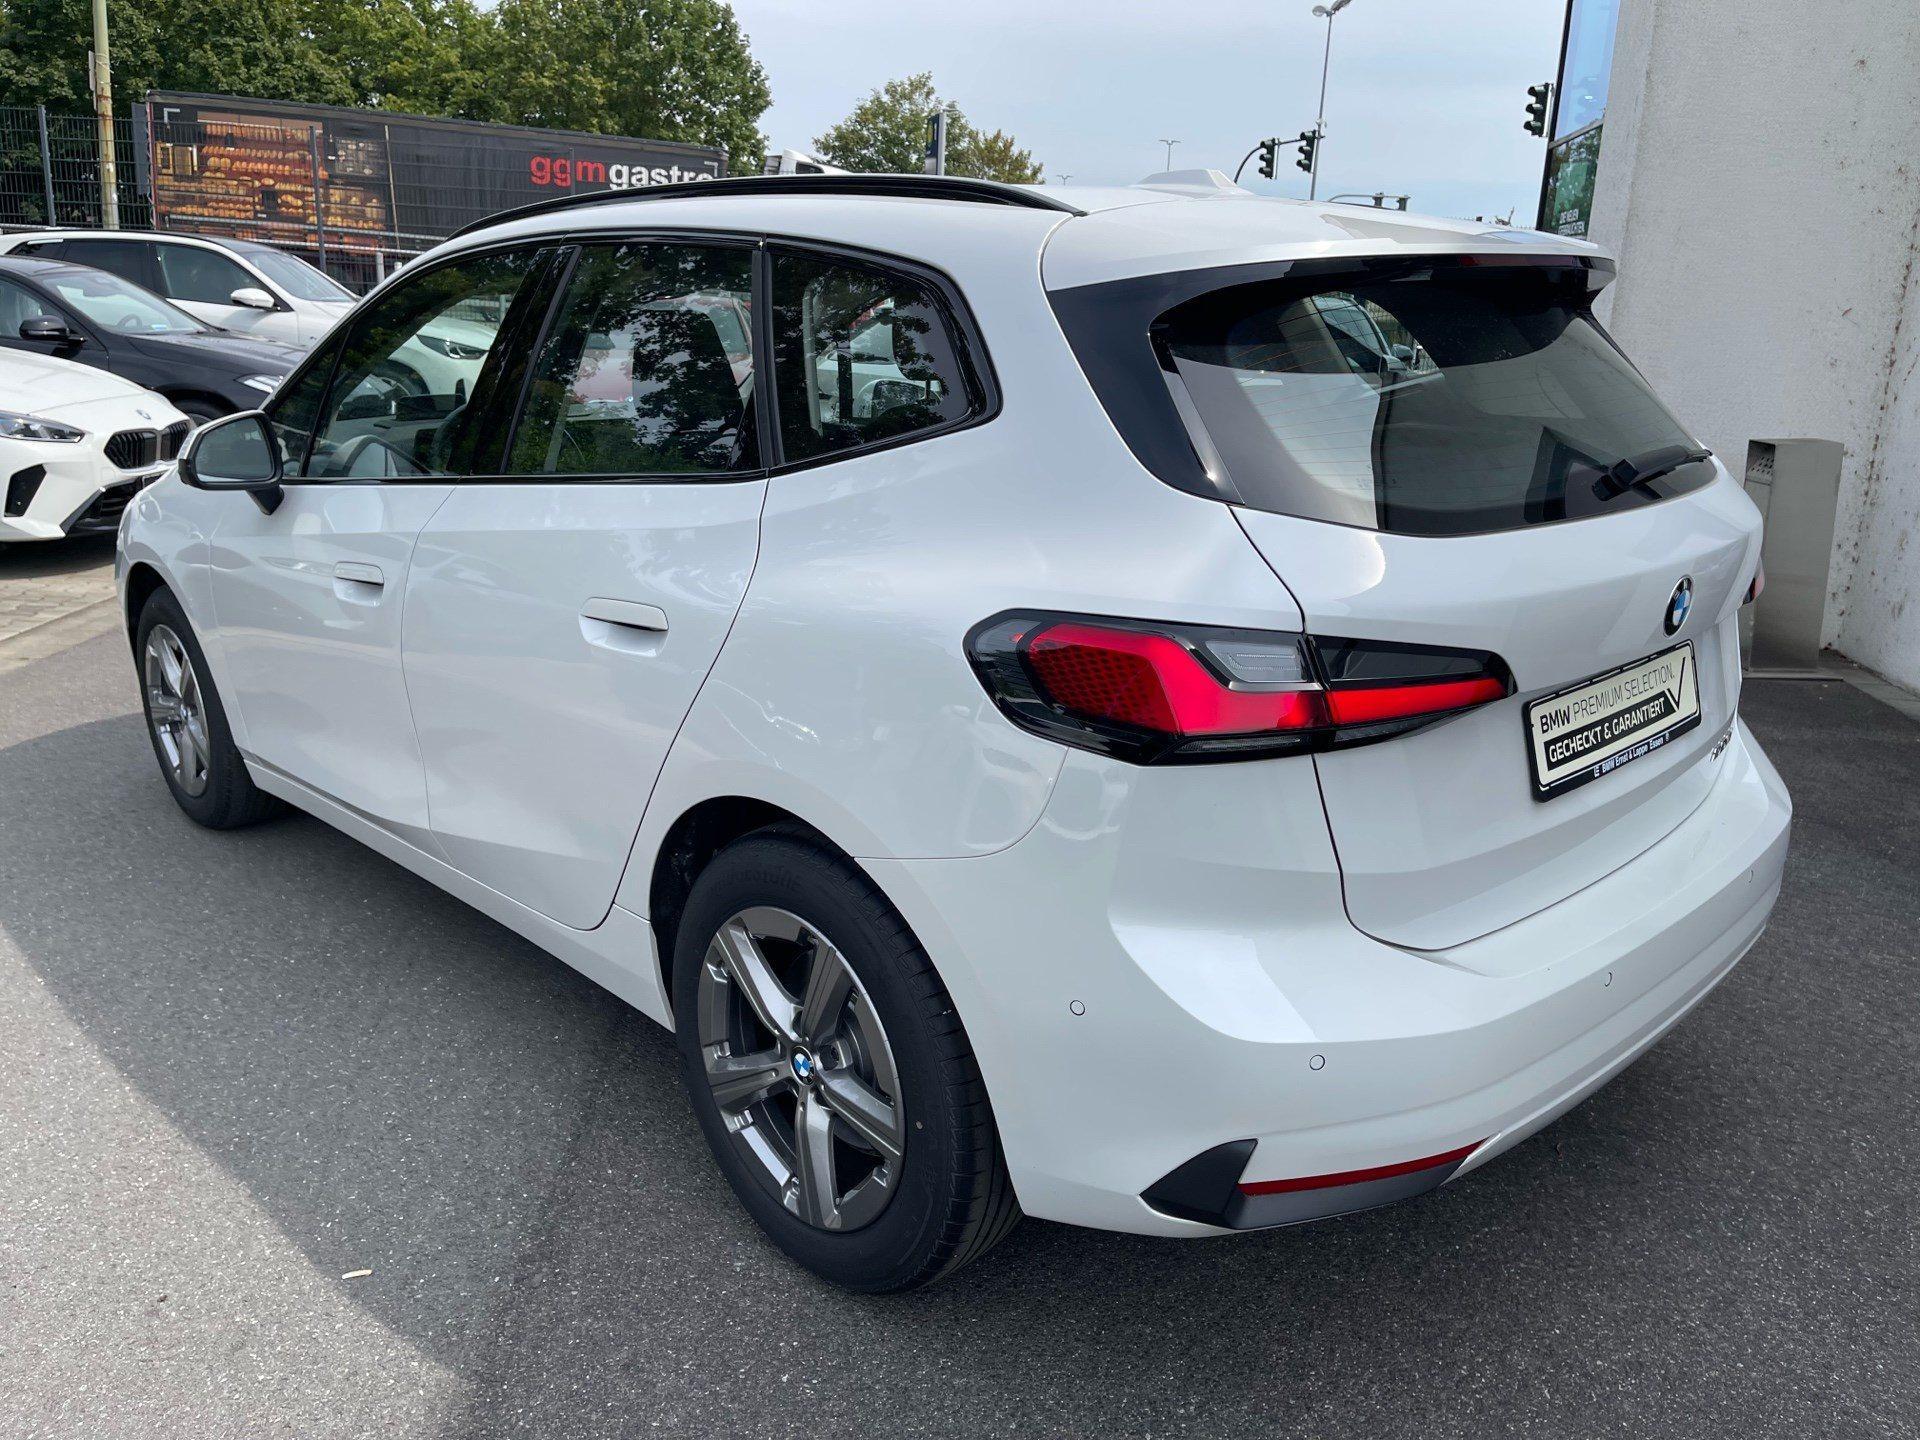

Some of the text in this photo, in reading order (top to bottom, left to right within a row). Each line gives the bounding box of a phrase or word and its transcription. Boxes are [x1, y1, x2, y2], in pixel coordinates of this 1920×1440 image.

[1540, 705, 1571, 734] BMW
[1573, 685, 1624, 721] PREMIUM
[1549, 697, 1666, 763] GECHECKT & GARANTIERT
